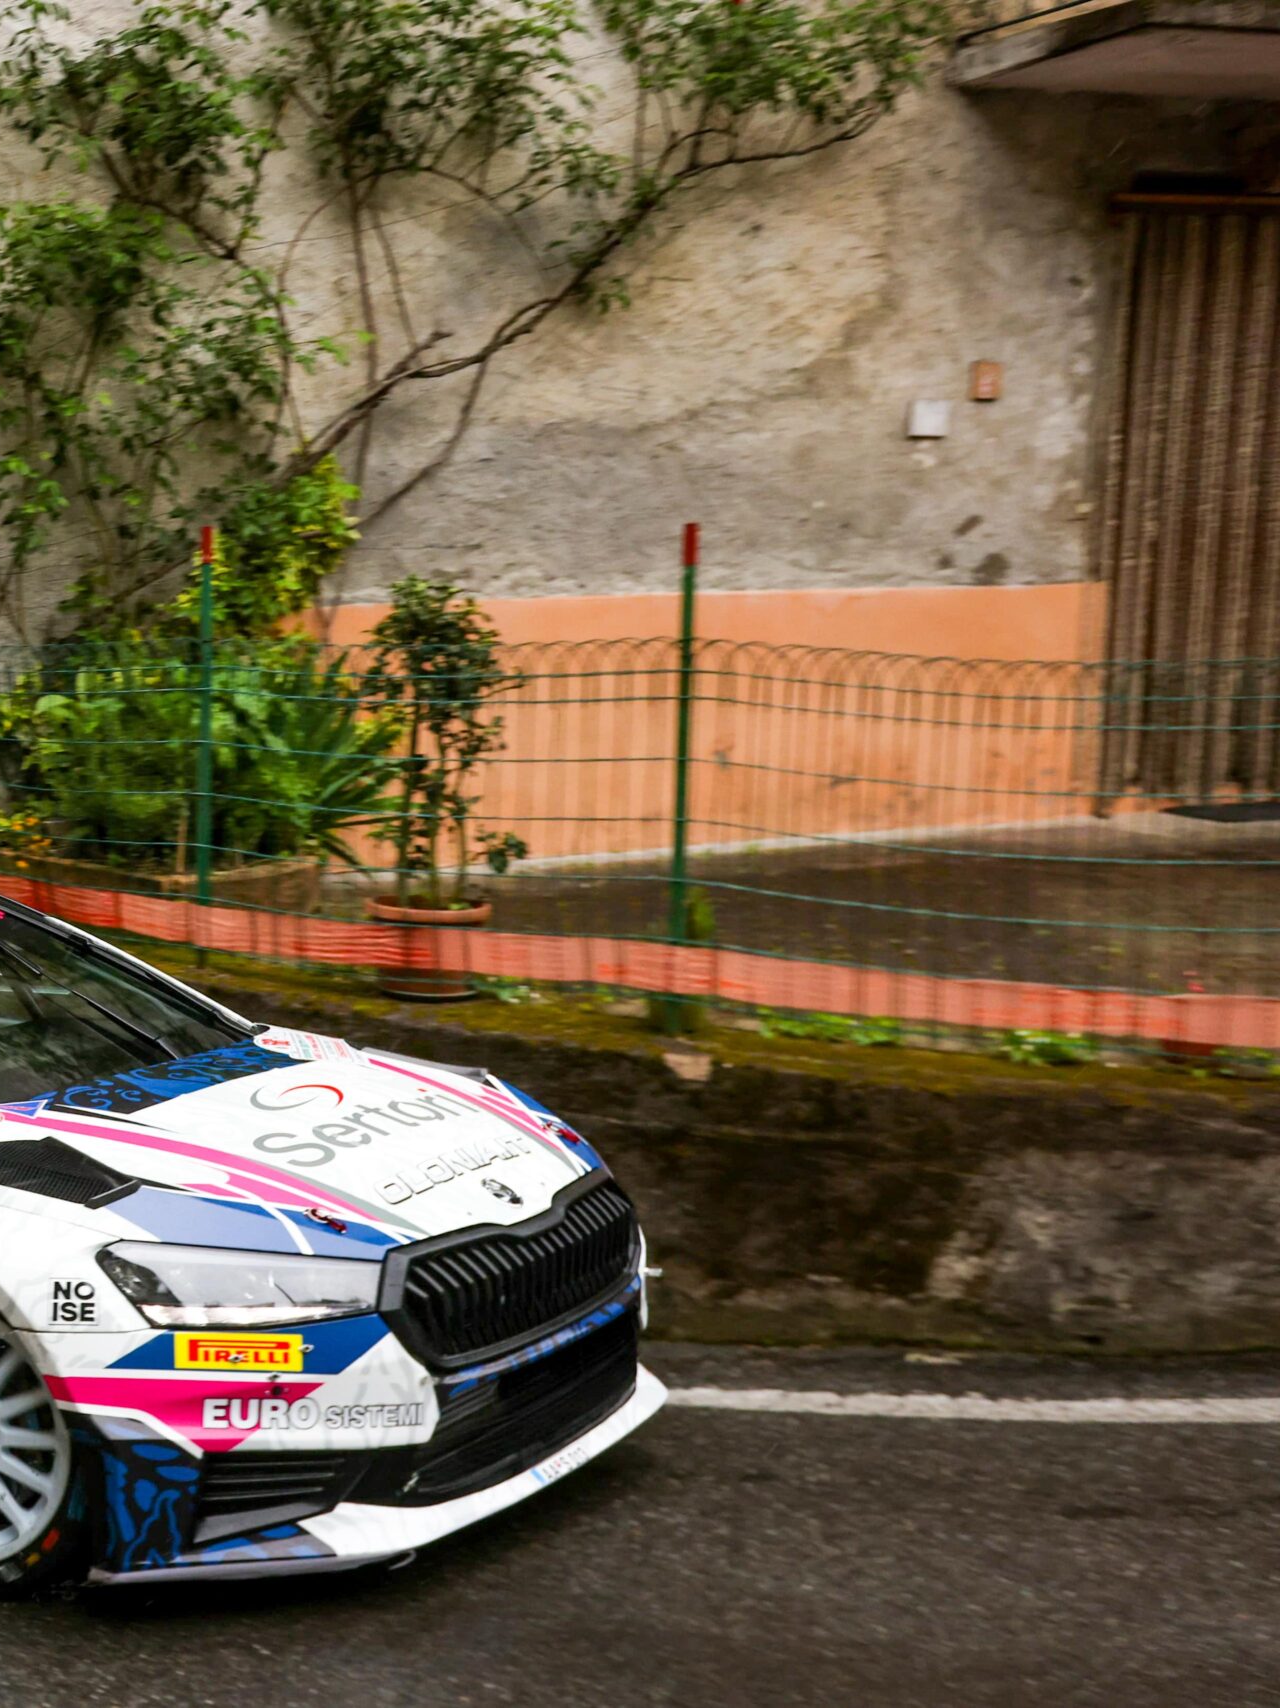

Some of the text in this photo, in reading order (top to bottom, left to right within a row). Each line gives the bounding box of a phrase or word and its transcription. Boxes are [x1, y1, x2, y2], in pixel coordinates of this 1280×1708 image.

[252, 1088, 480, 1168] Sertori
[53, 1281, 95, 1300] NO
[52, 1302, 95, 1322] ISE
[202, 1397, 426, 1430] EURO SISTEMI
